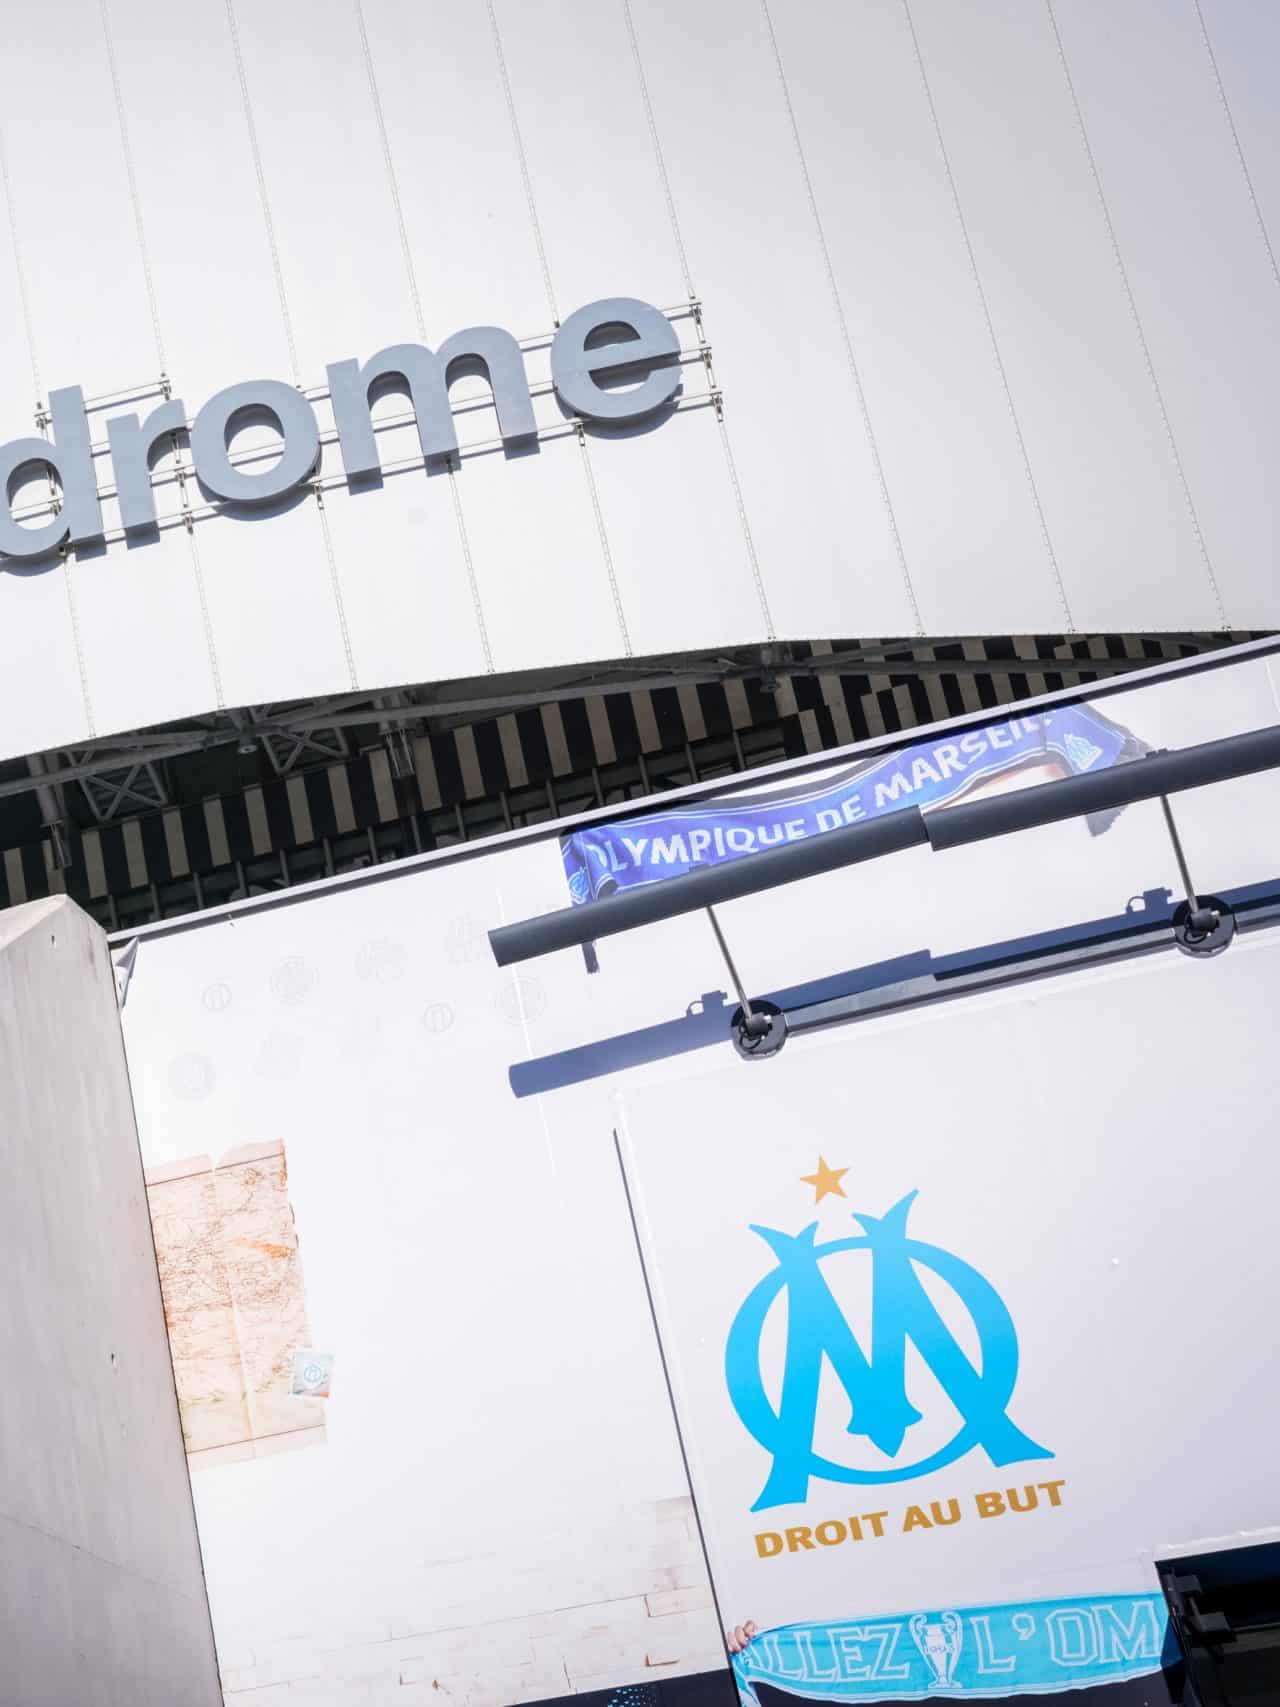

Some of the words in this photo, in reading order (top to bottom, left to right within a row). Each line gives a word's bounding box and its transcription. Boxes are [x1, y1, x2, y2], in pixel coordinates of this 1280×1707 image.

[816, 795, 866, 834] DE
[754, 1511, 889, 1558] DROIT
[902, 1498, 962, 1532] AU
[975, 1480, 1066, 1519] BUT
